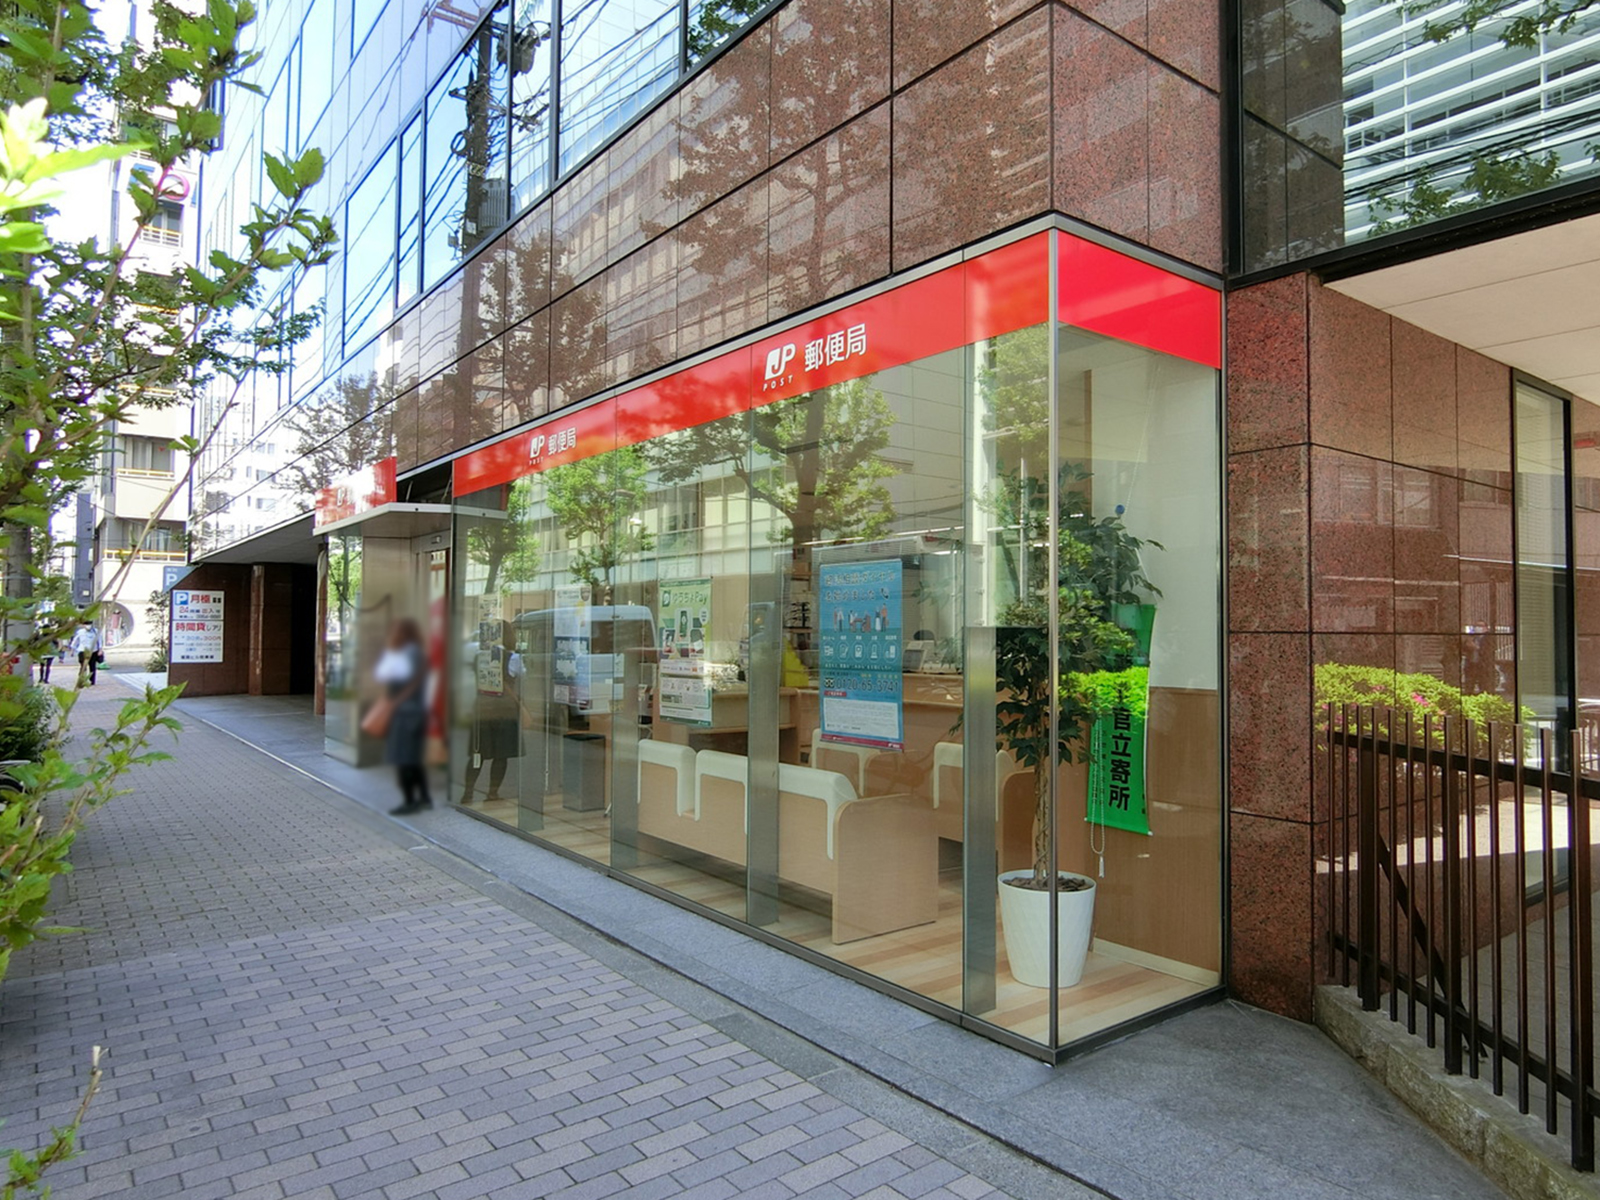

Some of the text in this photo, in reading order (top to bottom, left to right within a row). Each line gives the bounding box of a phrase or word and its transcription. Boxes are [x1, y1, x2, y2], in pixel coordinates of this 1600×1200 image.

[804, 323, 867, 372] 郵便局
[762, 375, 793, 391] POST
[548, 427, 576, 455] 郵便局
[166, 573, 178, 586] P
[175, 593, 188, 605] P
